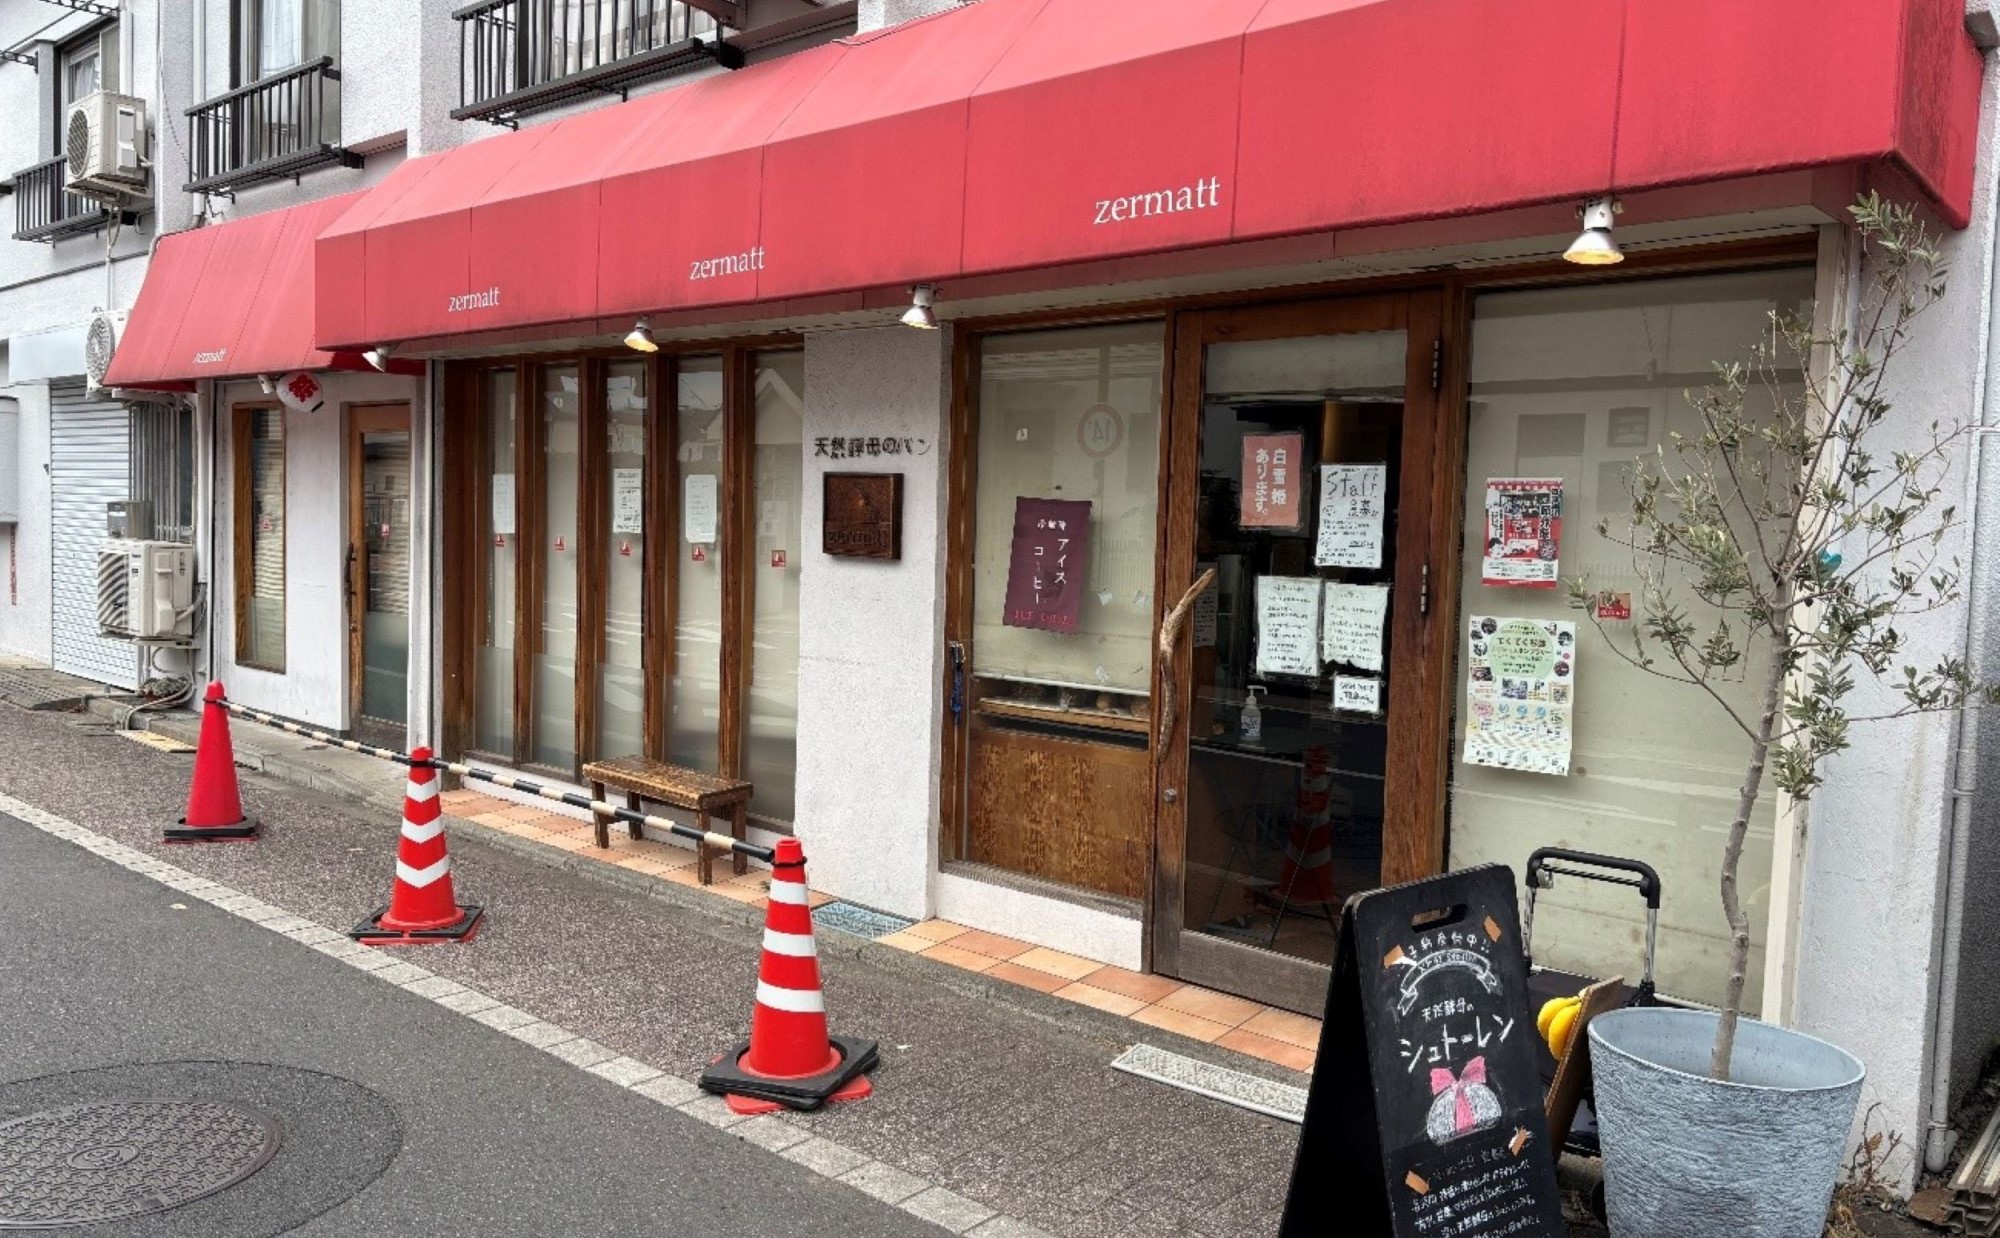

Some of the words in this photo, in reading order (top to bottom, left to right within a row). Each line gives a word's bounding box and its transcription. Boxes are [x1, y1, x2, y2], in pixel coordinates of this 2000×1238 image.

[1094, 176, 1221, 224] zermatt
[690, 246, 765, 280] zermatt
[448, 286, 501, 312] zermatt
[1254, 448, 1270, 515] あります。
[1325, 471, 1378, 498] Staff
[1033, 546, 1045, 604] コーヒー
[1054, 538, 1070, 585] アイス
[1398, 1013, 1515, 1074] シュトーレン
